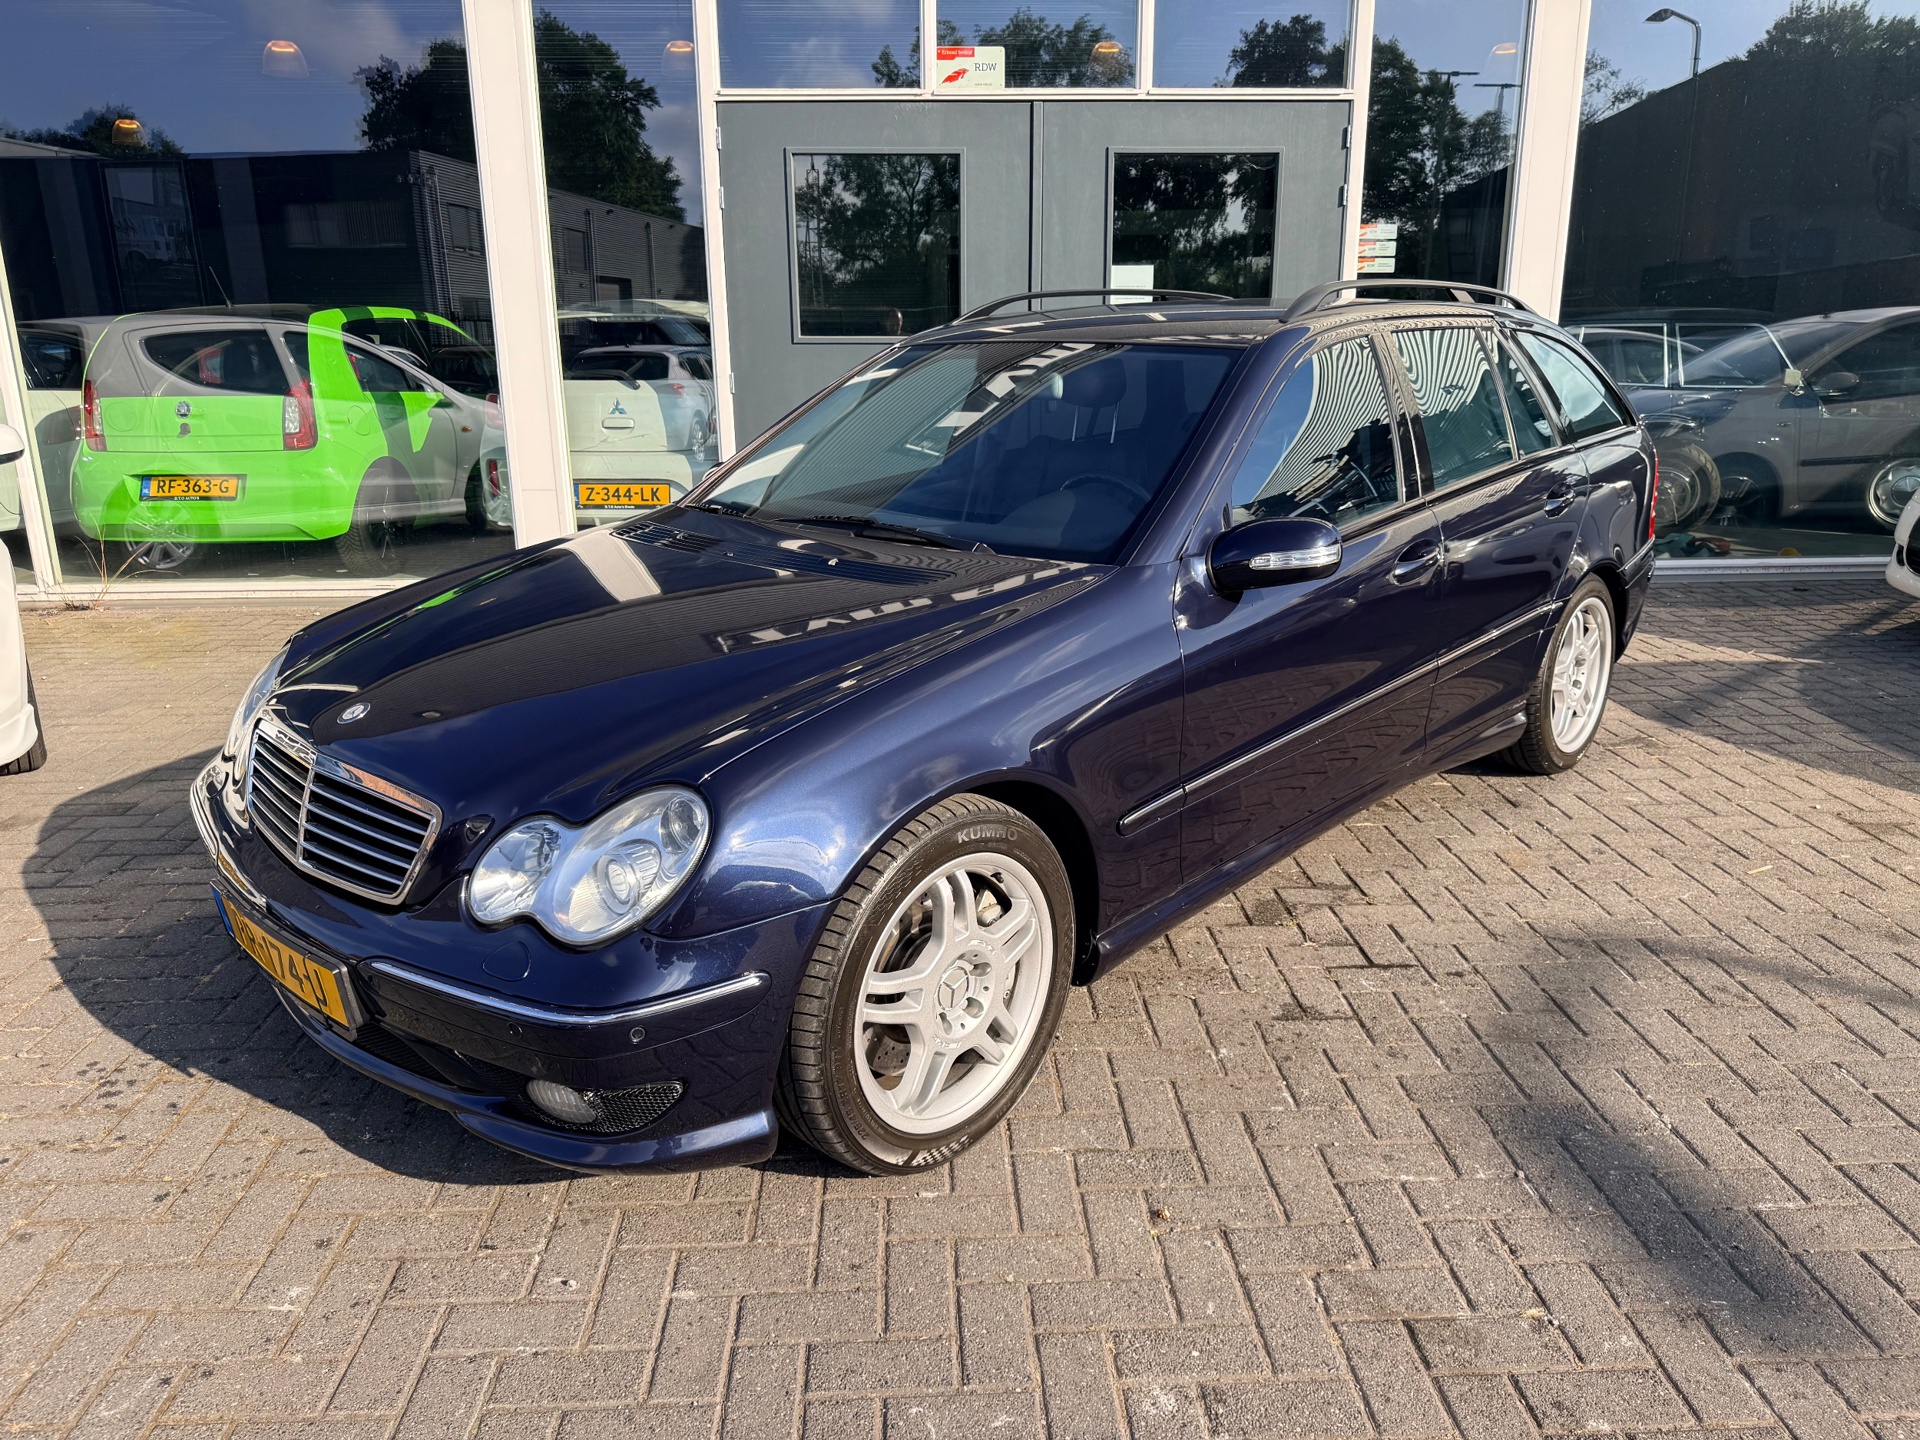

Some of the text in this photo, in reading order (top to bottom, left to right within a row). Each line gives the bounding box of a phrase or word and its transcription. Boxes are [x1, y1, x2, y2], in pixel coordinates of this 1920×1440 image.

[974, 62, 997, 72] RDW
[156, 479, 230, 494] RF-363-G
[585, 487, 661, 502] Z-344-LK
[956, 823, 1019, 844] KUMHO
